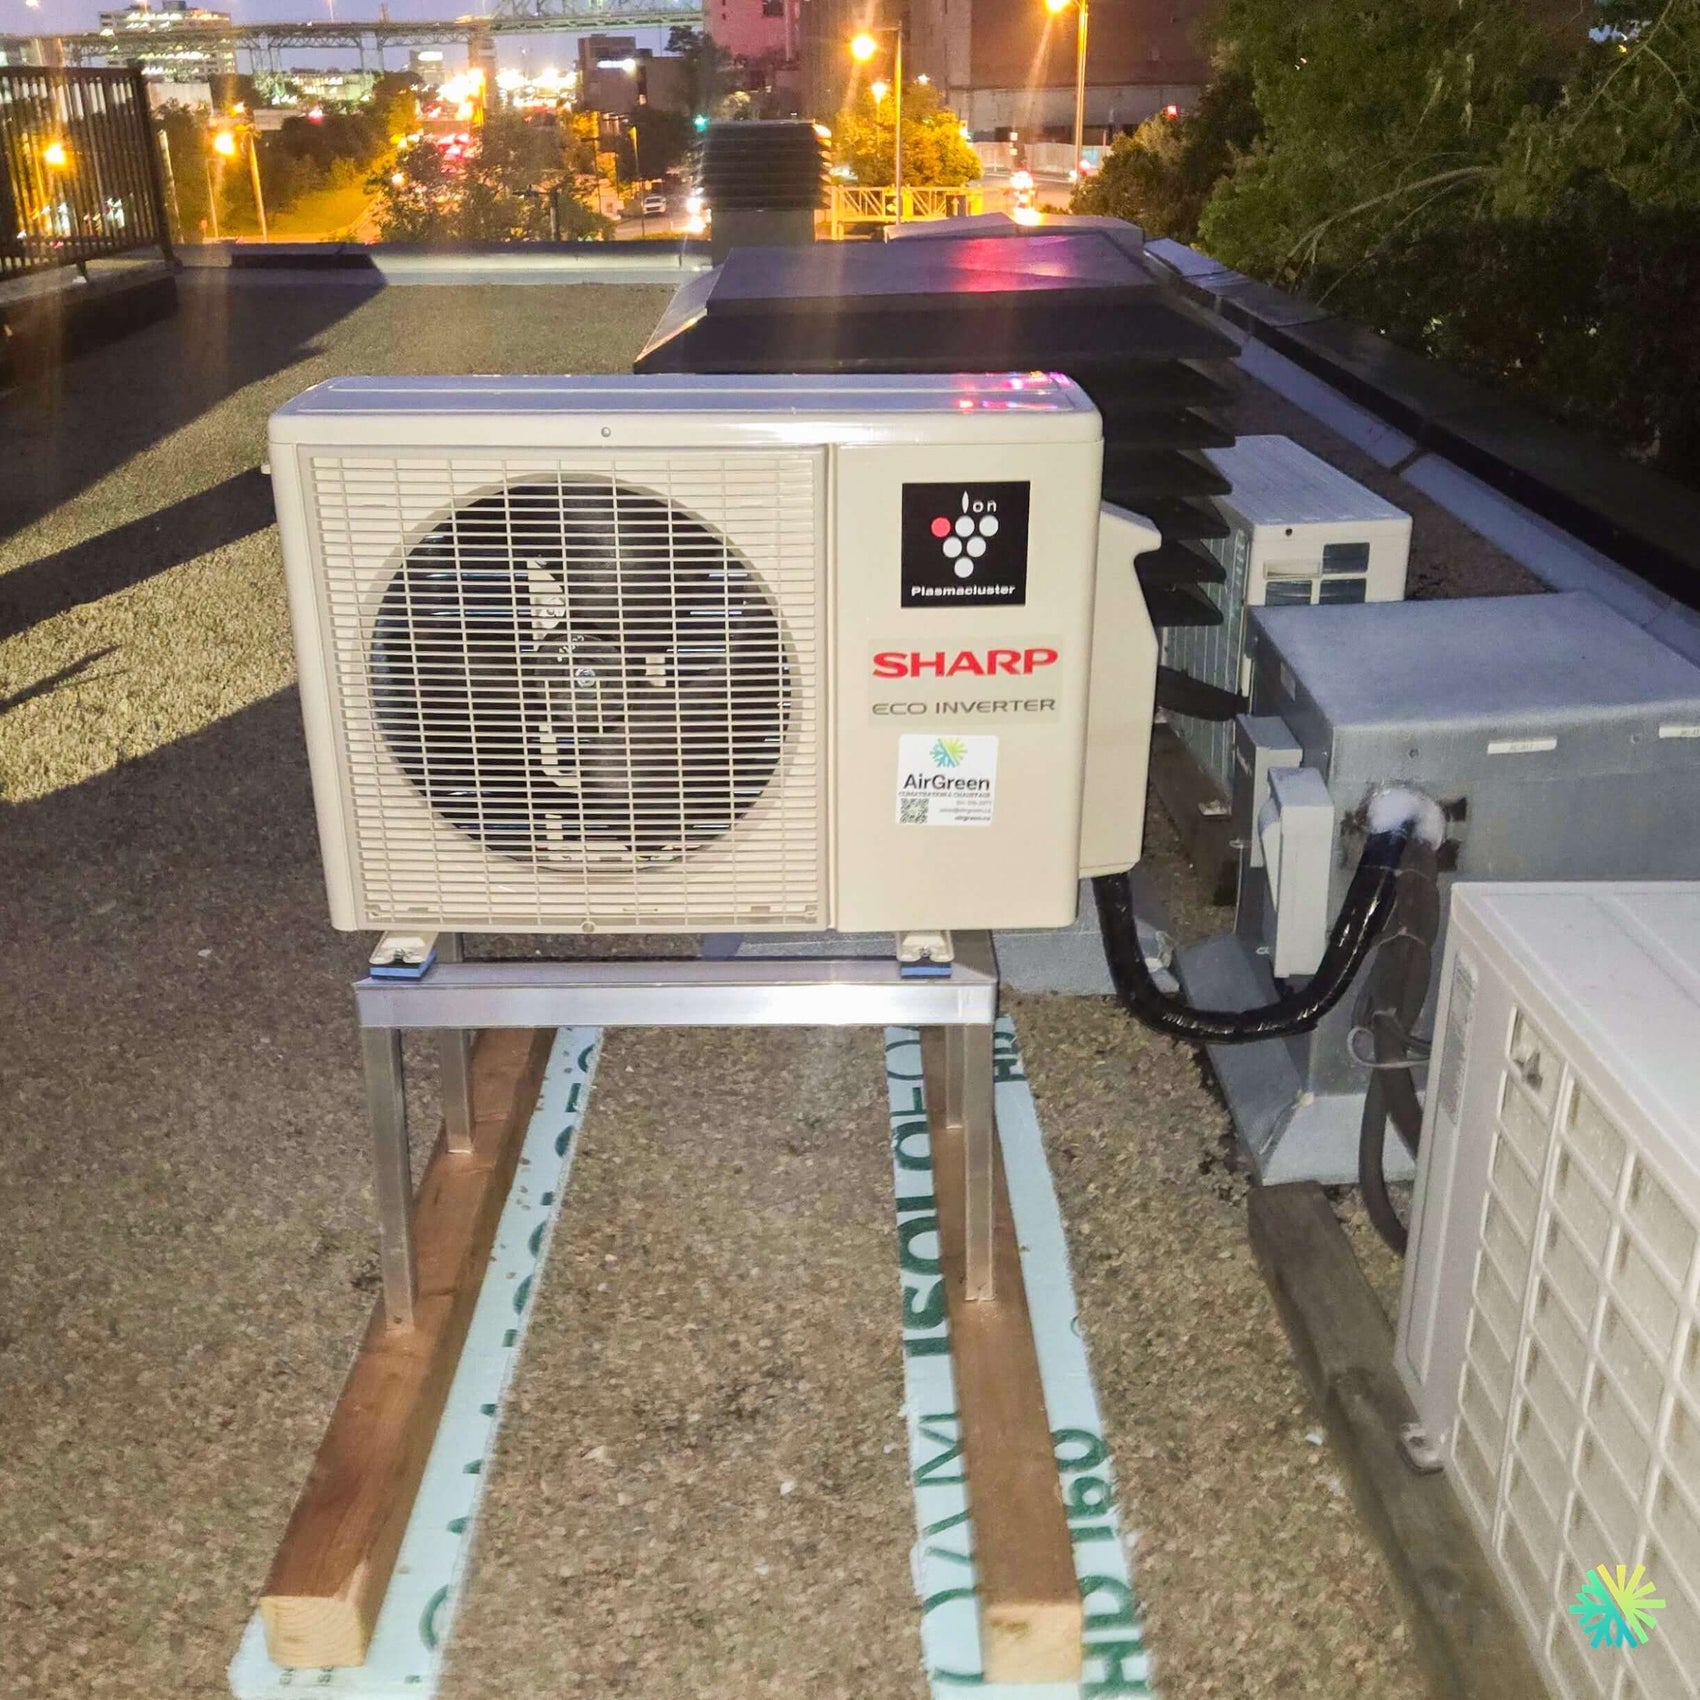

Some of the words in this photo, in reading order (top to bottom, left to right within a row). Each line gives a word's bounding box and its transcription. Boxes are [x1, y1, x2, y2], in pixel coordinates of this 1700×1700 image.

[911, 585, 1016, 597] Plasmacluster
[872, 648, 1059, 679] SHARP
[872, 702, 927, 716] ECO
[936, 698, 1056, 715] INVERTER
[903, 773, 990, 791] AirGreen
